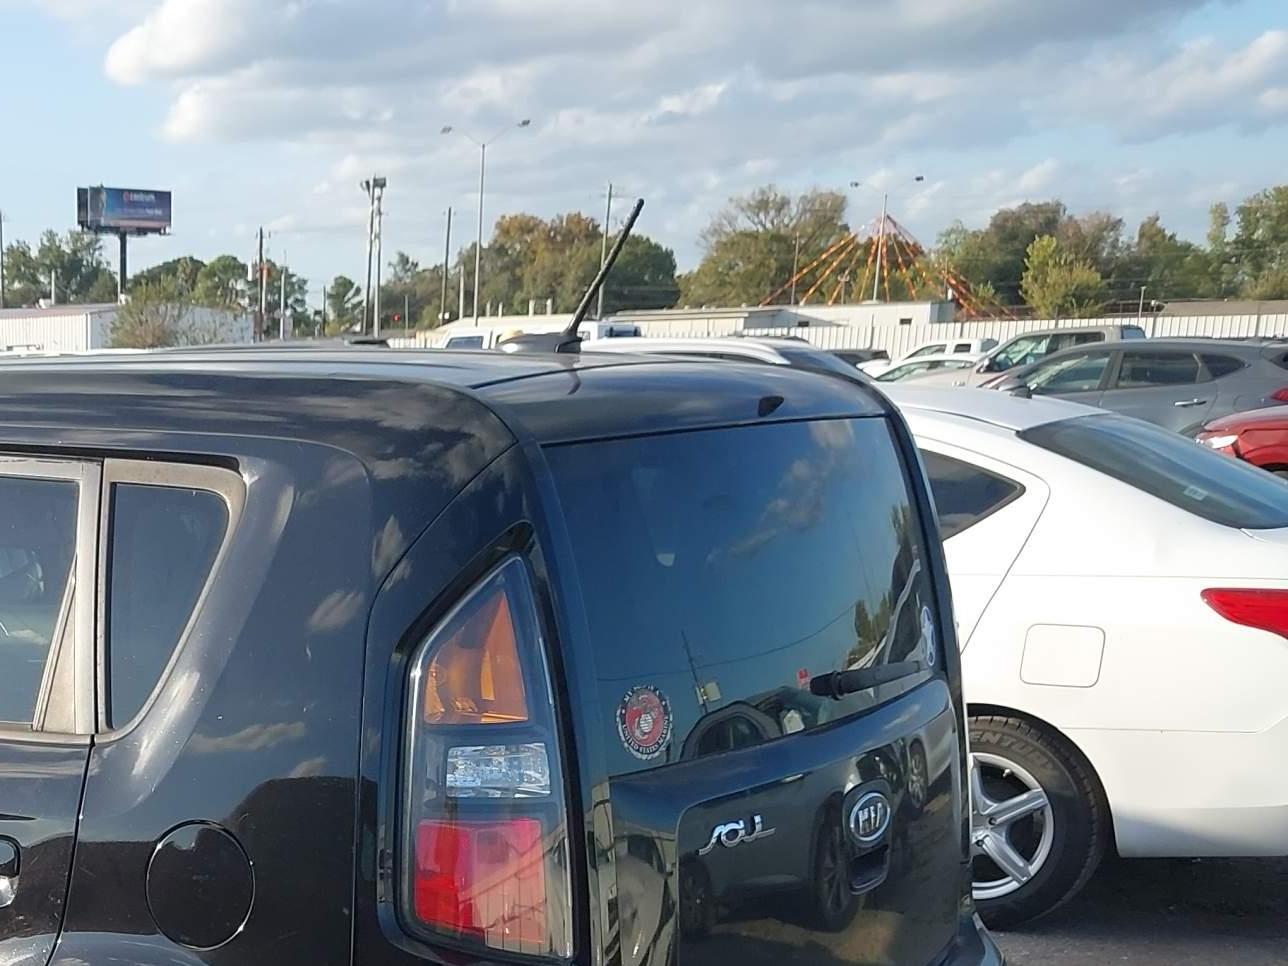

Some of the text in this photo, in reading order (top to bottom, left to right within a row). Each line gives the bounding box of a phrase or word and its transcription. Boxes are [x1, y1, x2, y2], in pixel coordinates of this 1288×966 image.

[622, 724, 639, 750] UNITED
[639, 743, 659, 754] STATES
[857, 802, 883, 835] KIA
